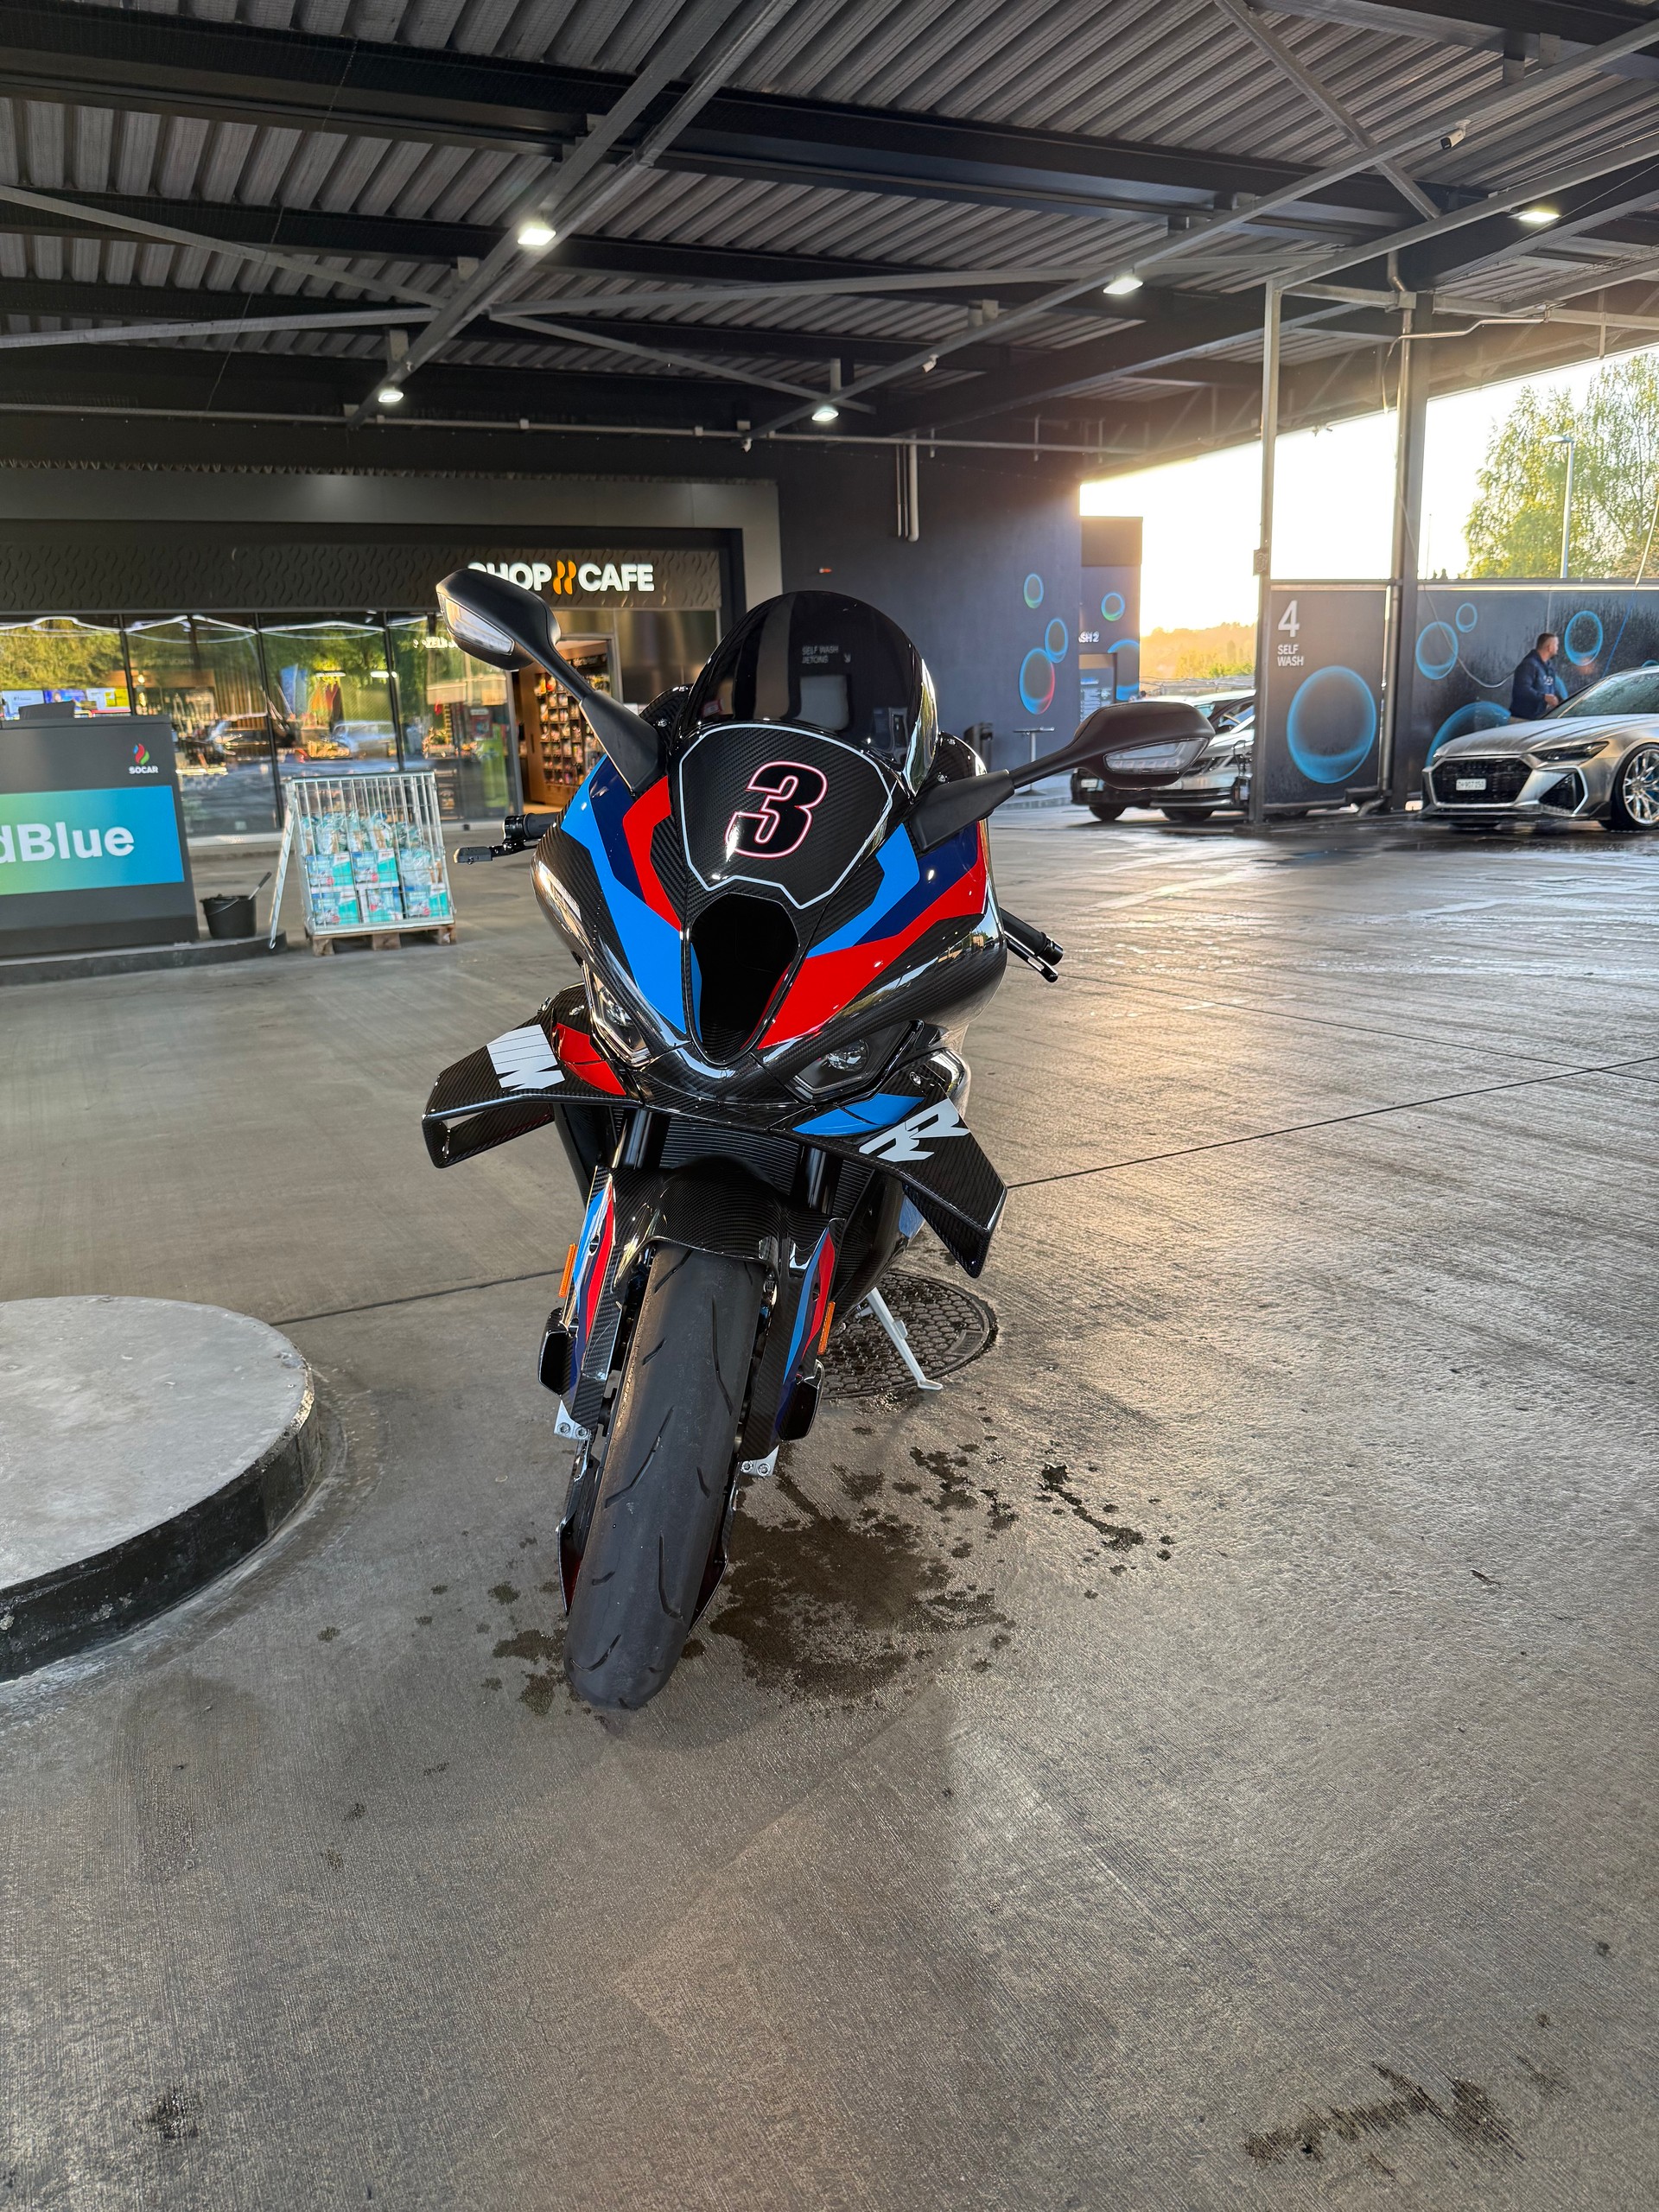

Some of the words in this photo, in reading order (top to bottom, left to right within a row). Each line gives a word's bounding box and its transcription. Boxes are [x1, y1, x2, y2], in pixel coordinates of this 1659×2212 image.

[467, 563, 552, 591] HOP
[578, 563, 655, 592] CAFE
[1277, 599, 1300, 638] 4
[1092, 631, 1100, 643] 2
[802, 645, 818, 655] SELF
[819, 645, 839, 654] WASH
[1277, 644, 1300, 655] SELF
[1277, 656, 1305, 667] WASH
[129, 766, 159, 774] SOCAR
[723, 760, 829, 860] 3
[858, 1097, 971, 1163] RR
